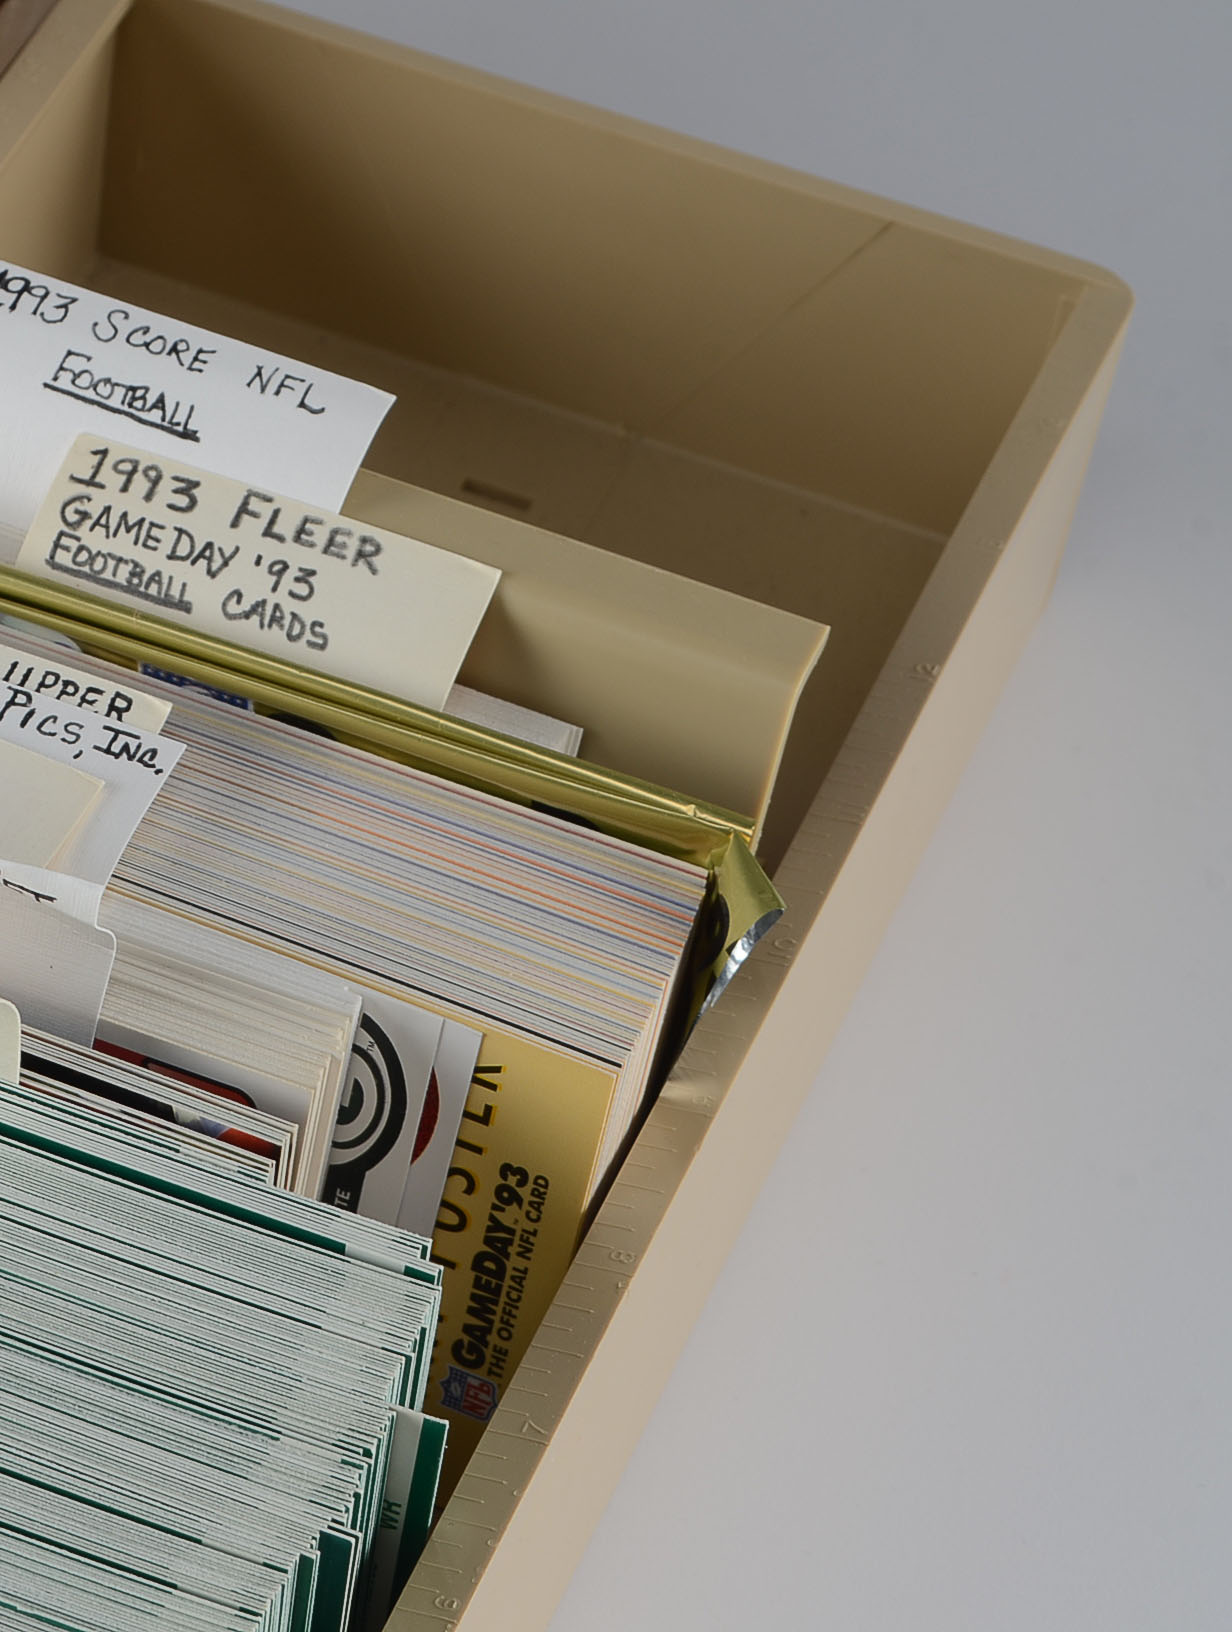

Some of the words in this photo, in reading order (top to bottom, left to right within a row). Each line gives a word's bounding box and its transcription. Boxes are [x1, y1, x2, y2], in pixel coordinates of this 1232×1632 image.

[46, 350, 200, 438] FOOTBALL
[92, 309, 217, 374] SCORE
[246, 365, 325, 415] NFL
[59, 495, 240, 579] GAMEDAY
[254, 554, 318, 602] '93
[70, 447, 202, 513] 1993
[229, 488, 383, 577] FLEER
[47, 530, 192, 609] FOOTBALL
[221, 588, 330, 652] CARDS
[516, 1226, 539, 1262] NFL
[525, 1174, 551, 1226] CARD
[496, 1263, 529, 1343] OFFICIAL
[487, 1344, 509, 1379] THE
